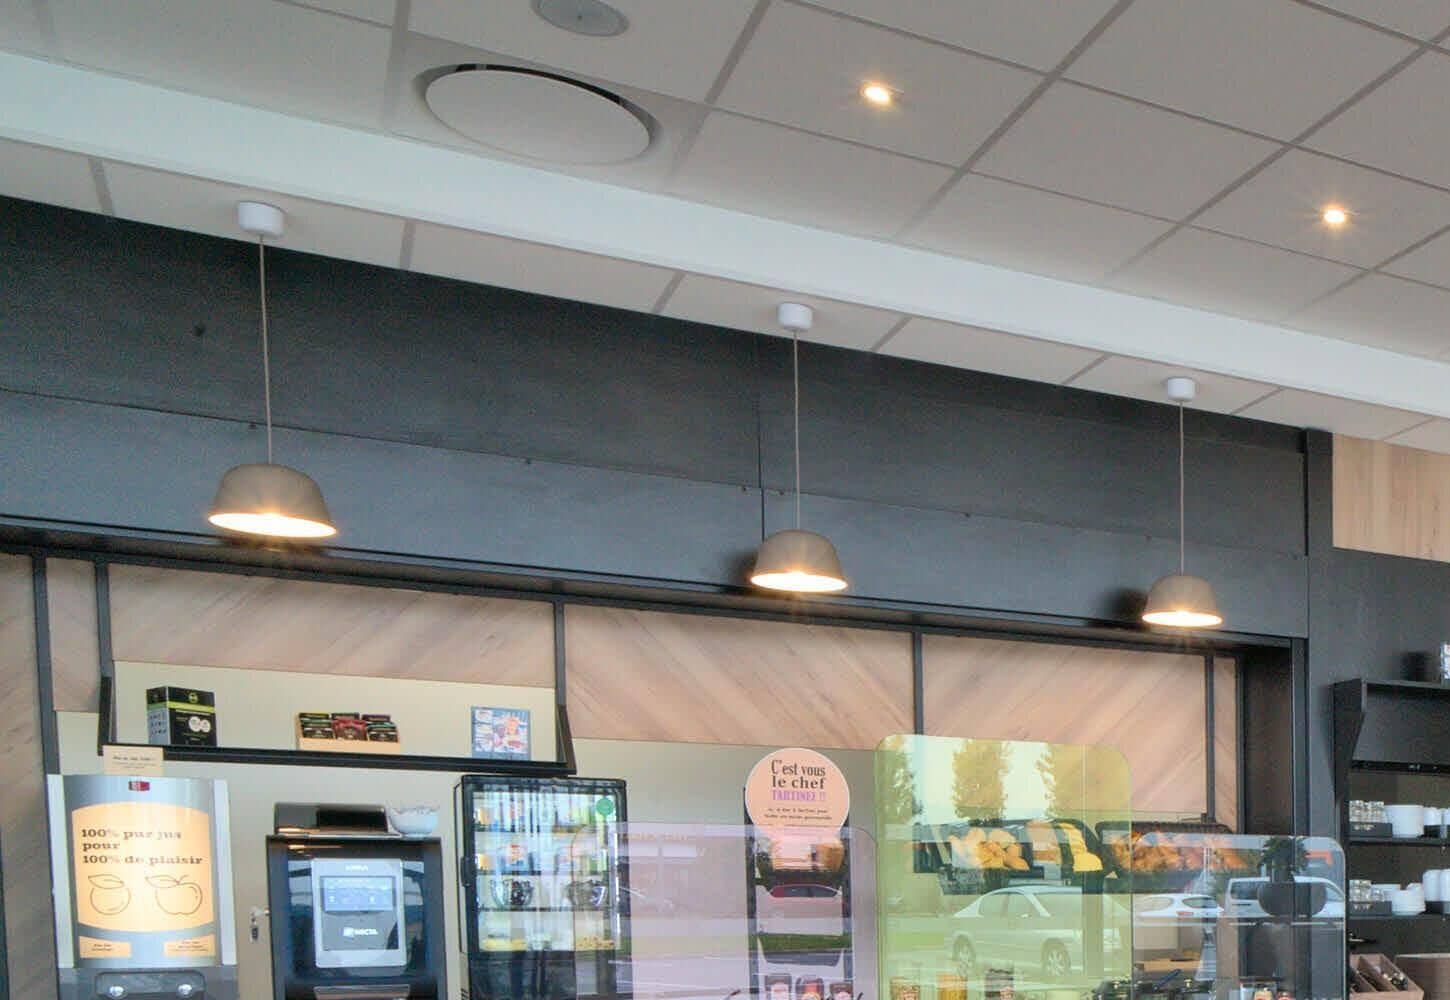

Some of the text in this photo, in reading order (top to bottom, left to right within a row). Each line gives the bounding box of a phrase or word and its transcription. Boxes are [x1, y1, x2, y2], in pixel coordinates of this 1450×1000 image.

[771, 760, 826, 776] C'est vous
[772, 775, 826, 790] le chef
[82, 843, 121, 852] pour
[149, 855, 203, 866] plaisir
